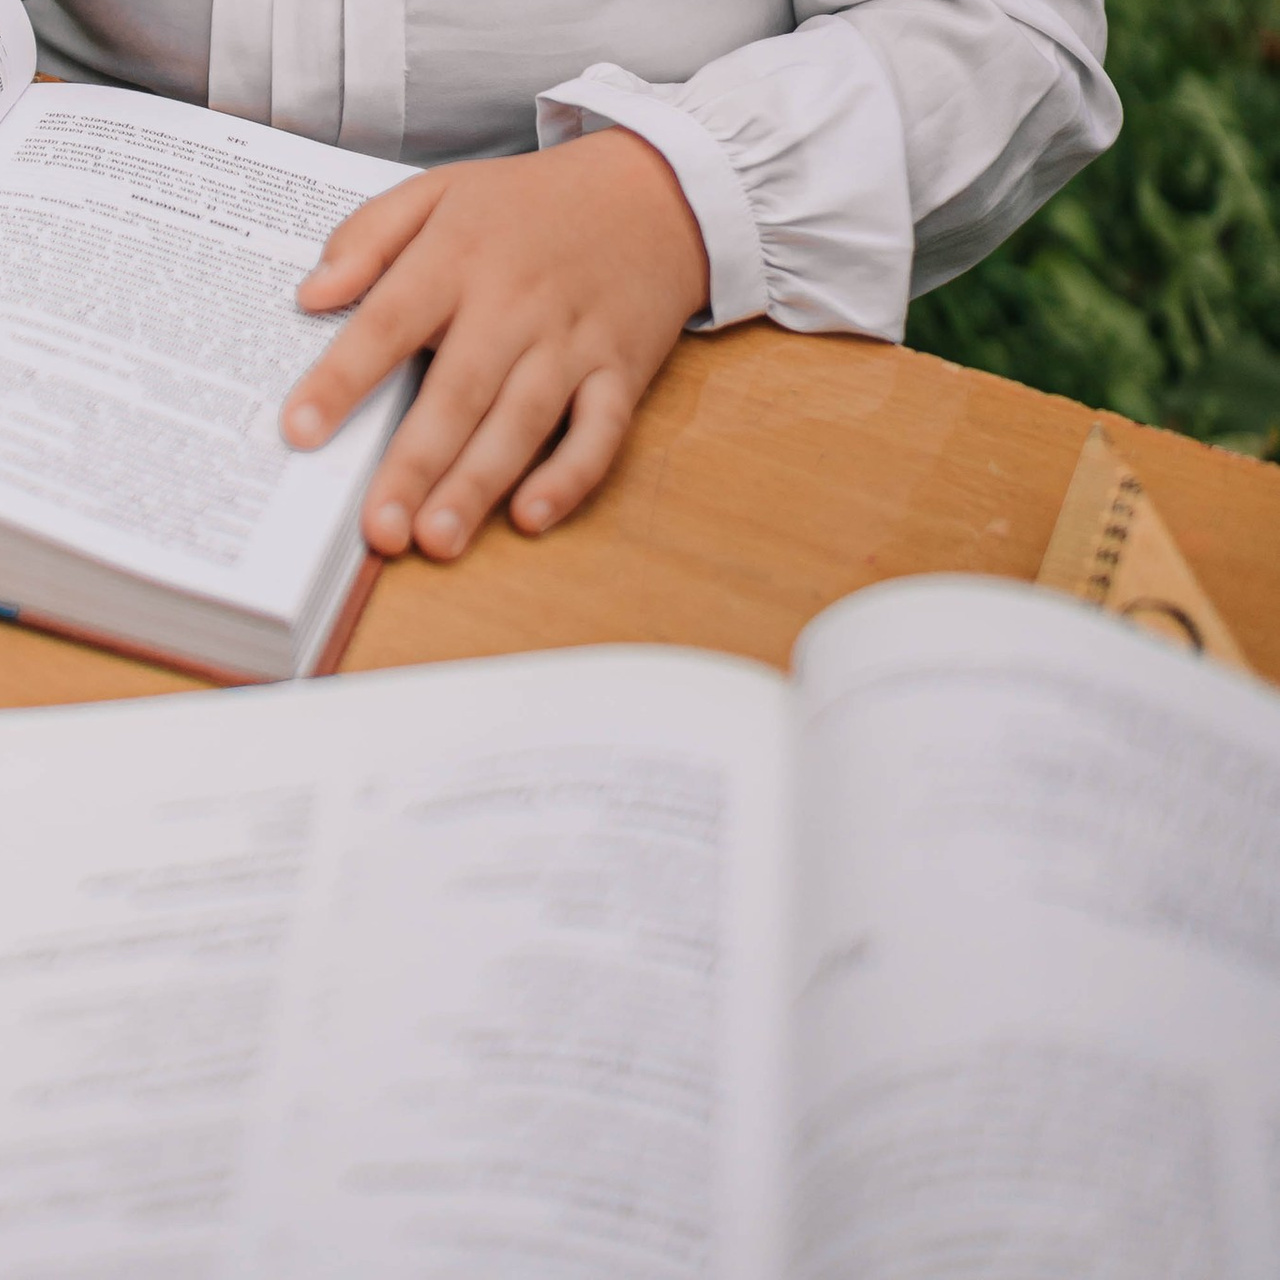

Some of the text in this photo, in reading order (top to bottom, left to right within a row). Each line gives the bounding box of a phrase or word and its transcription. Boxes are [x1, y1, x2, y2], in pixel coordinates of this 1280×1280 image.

[80, 116, 136, 131] третьего
[140, 127, 179, 142] сорок
[226, 136, 249, 147] 348
[181, 139, 230, 157] осенью
[233, 154, 318, 187] Призванный
